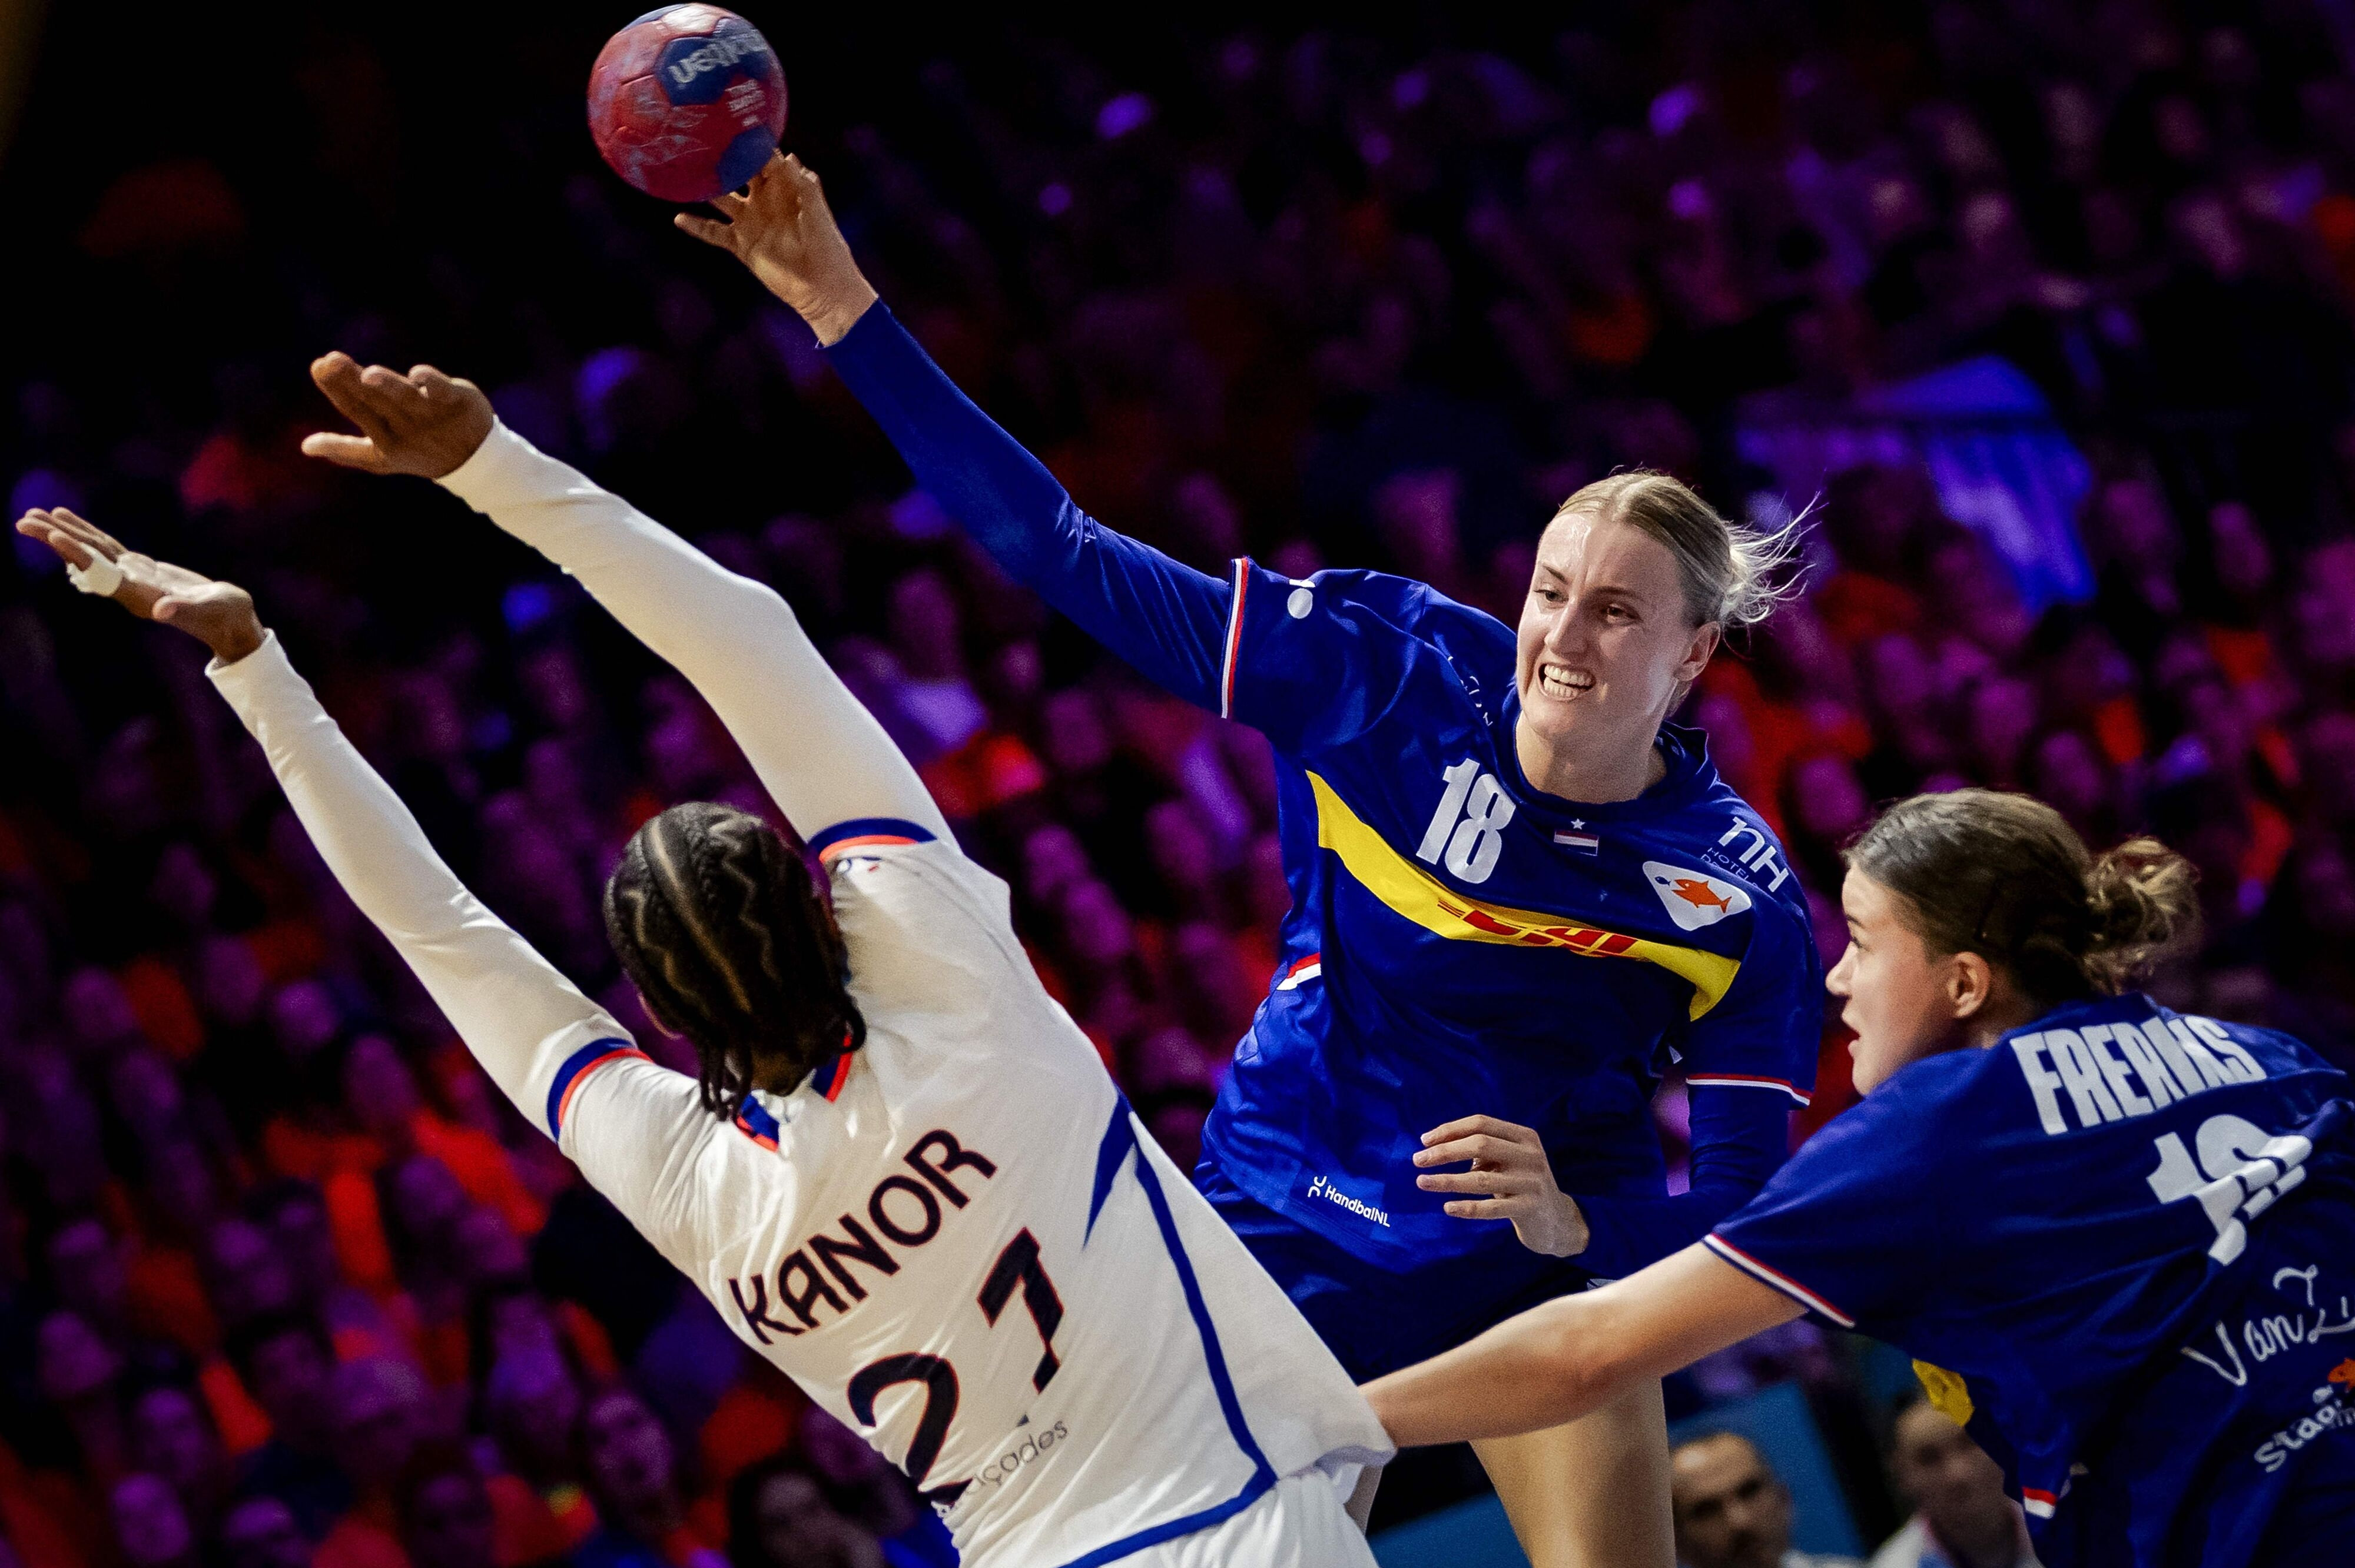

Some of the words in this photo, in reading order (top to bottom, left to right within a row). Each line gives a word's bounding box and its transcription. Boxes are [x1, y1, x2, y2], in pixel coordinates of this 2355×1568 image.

[1415, 758, 1517, 884] 18
[728, 1128, 998, 1346] KANOR
[1324, 1184, 1391, 1228] HandbalNL
[847, 1226, 1065, 1508] 27
